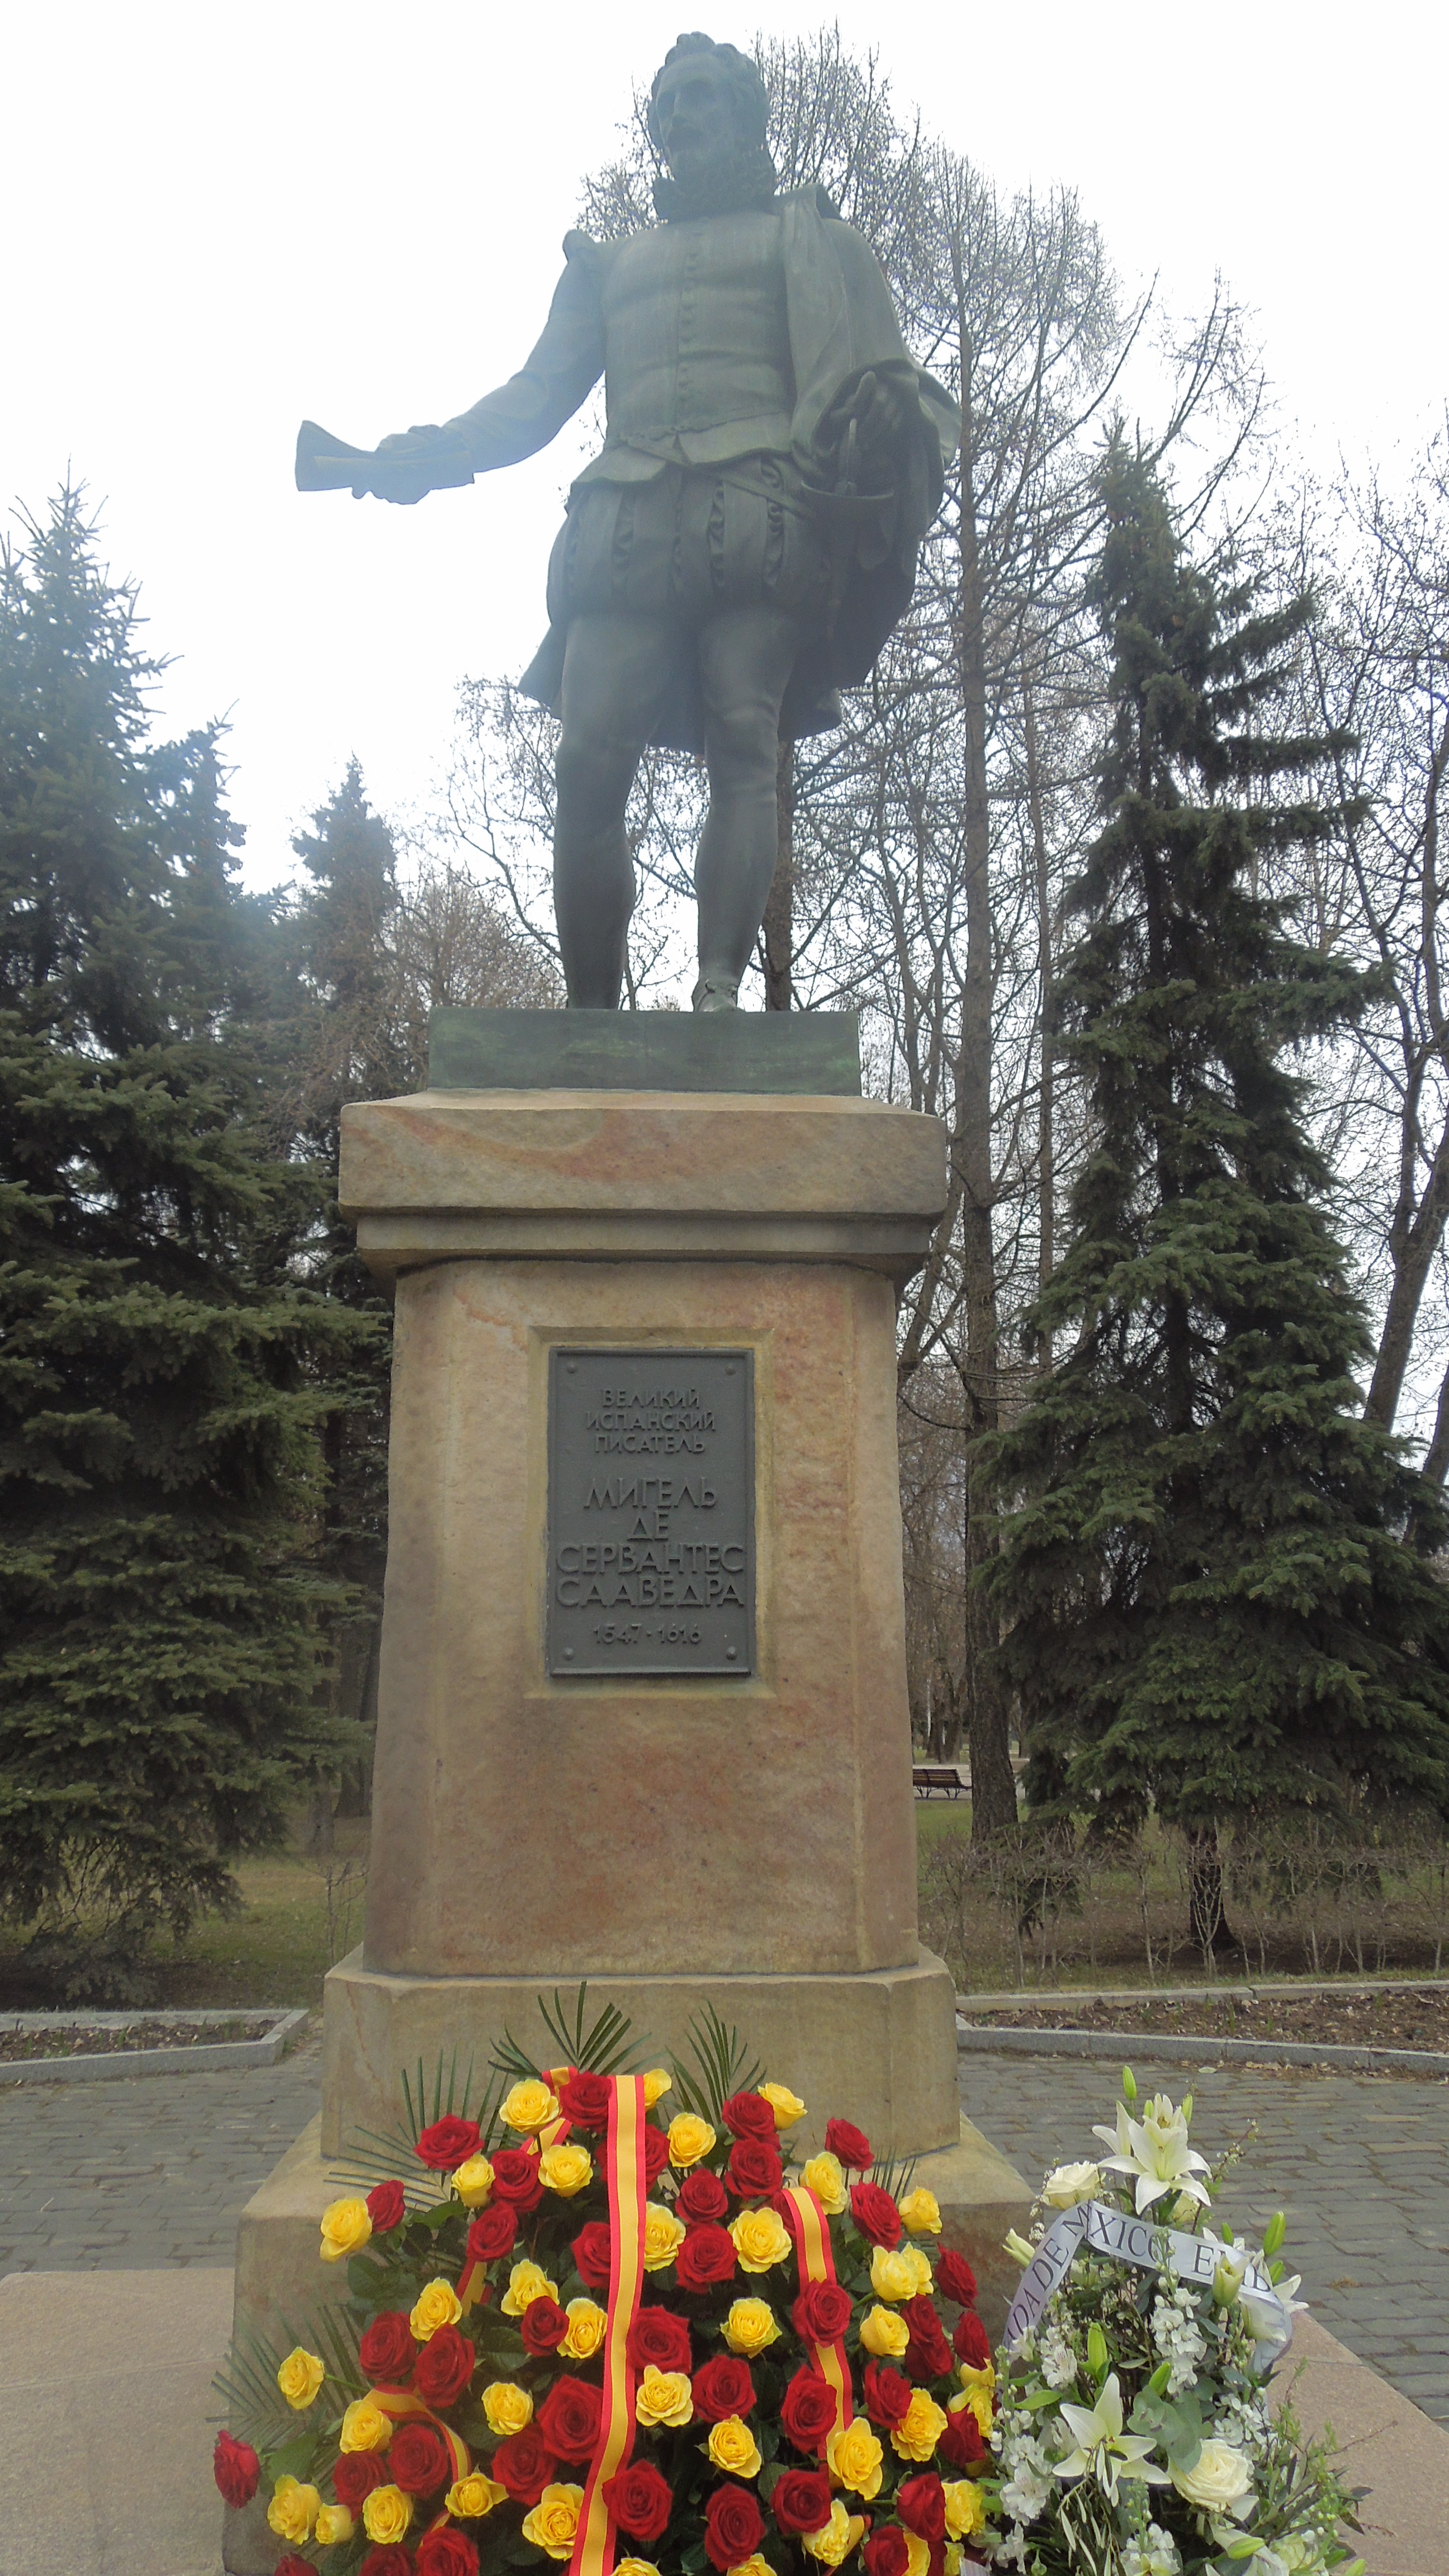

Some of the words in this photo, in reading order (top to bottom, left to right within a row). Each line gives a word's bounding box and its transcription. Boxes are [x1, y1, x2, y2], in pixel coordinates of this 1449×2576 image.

[601, 1389, 699, 1409] ВЕЛИКИЙ
[586, 1412, 716, 1432] ИСПАНСКИЙ
[595, 1434, 706, 1454] ПИСАТЕЛЬ
[583, 1478, 717, 1509] МИГЕЛЬ
[627, 1511, 669, 1540] ДЕ
[557, 1543, 745, 1574] СЕРВАНТЕС
[557, 1577, 745, 1607] СААВЕДРА
[1033, 2238, 1069, 2291] DE
